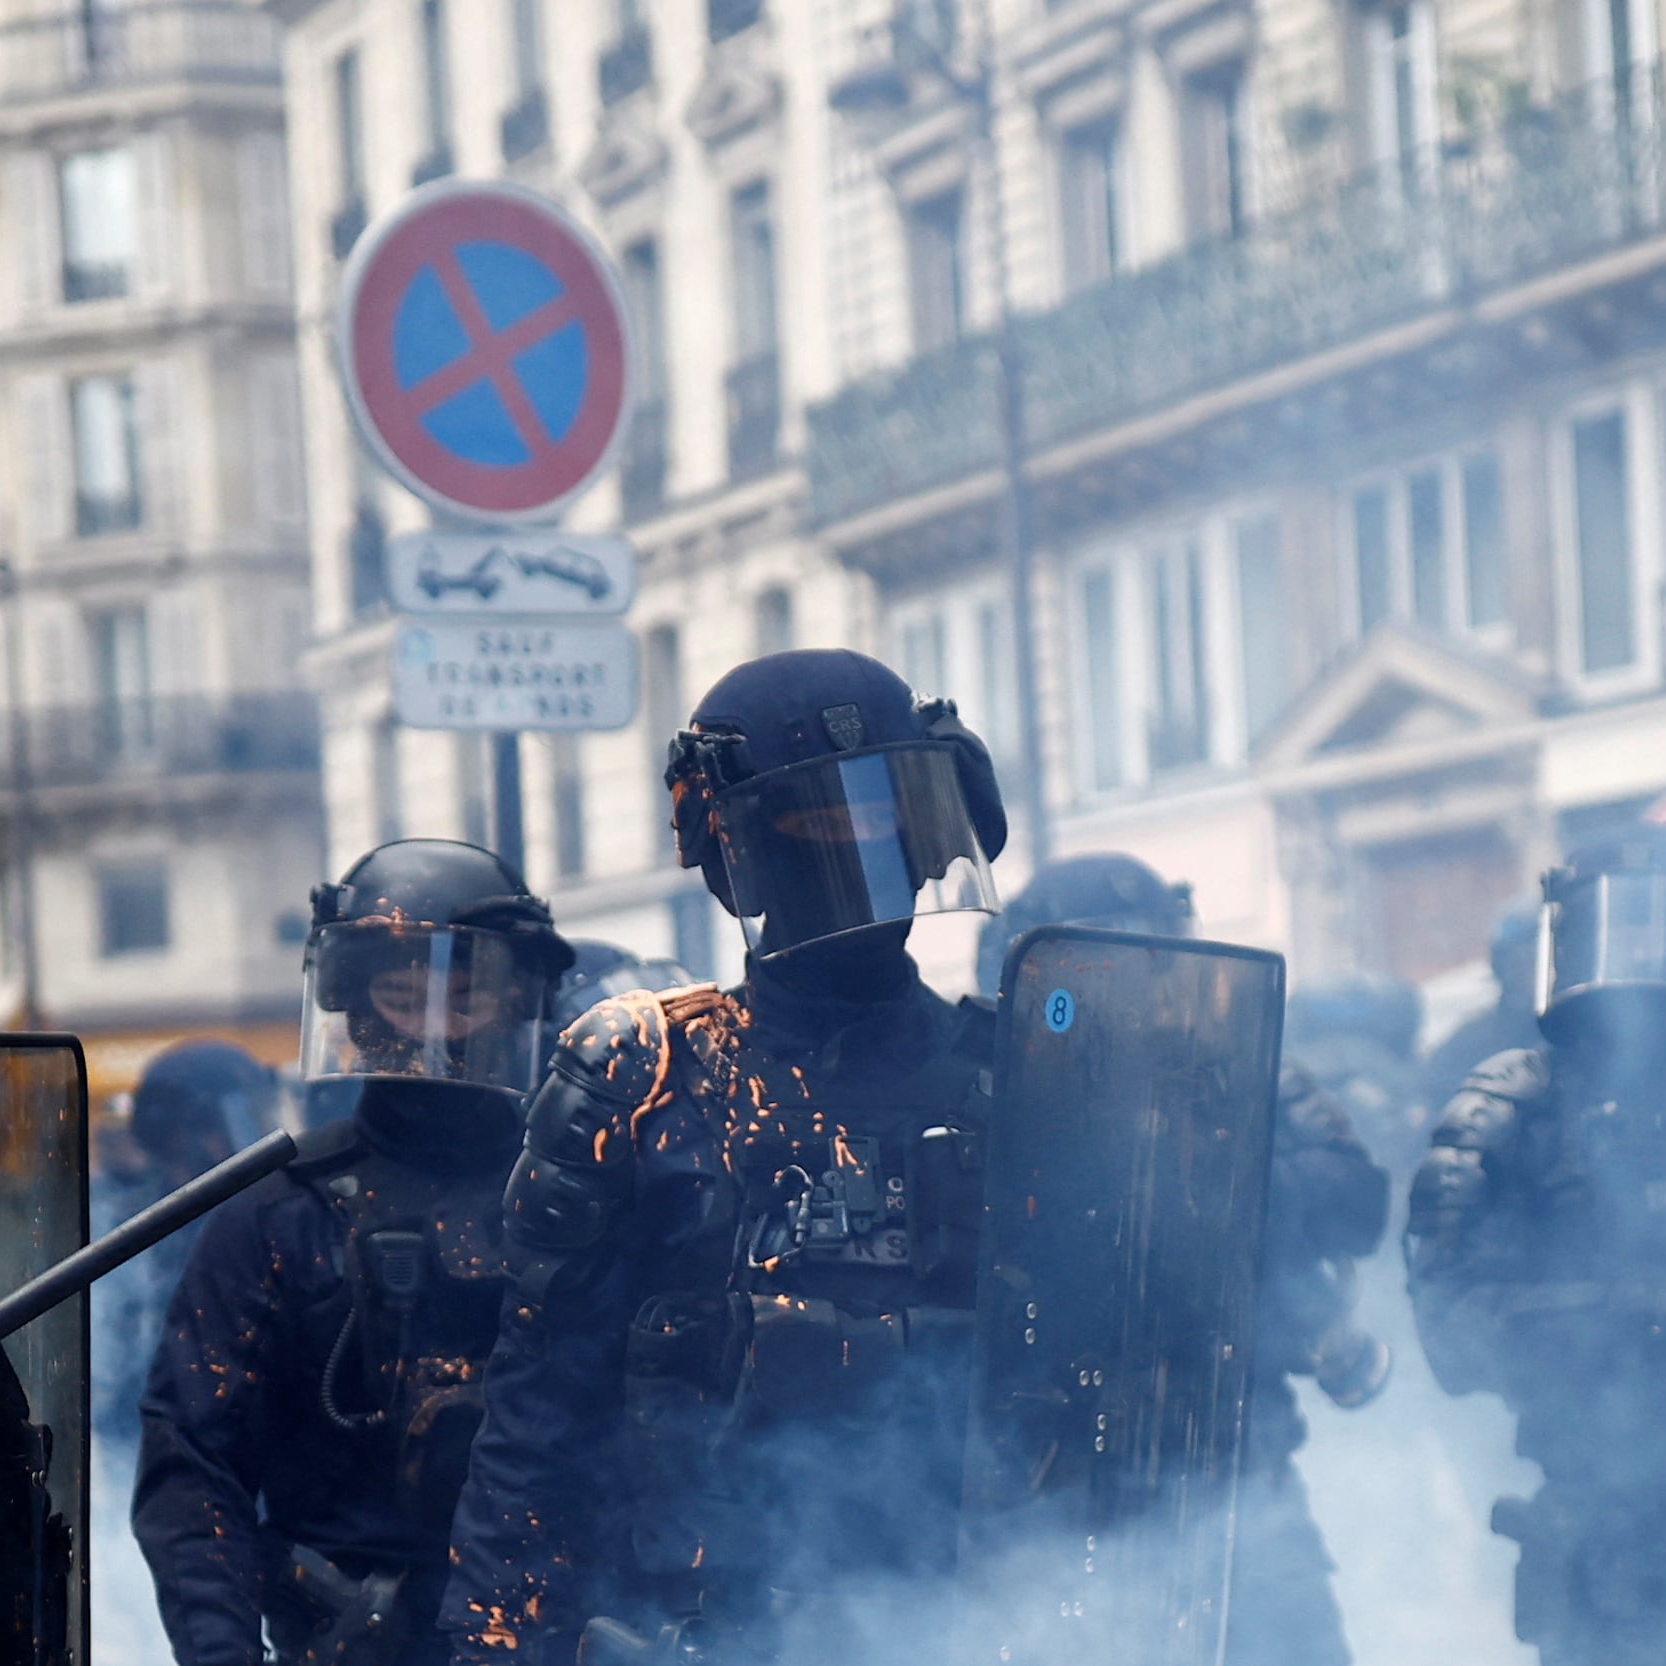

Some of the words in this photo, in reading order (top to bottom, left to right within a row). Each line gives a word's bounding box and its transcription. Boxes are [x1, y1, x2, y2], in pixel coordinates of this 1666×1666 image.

[475, 631, 557, 655] SAUF
[828, 717, 862, 733] CRS
[1052, 996, 1067, 1025] 8
